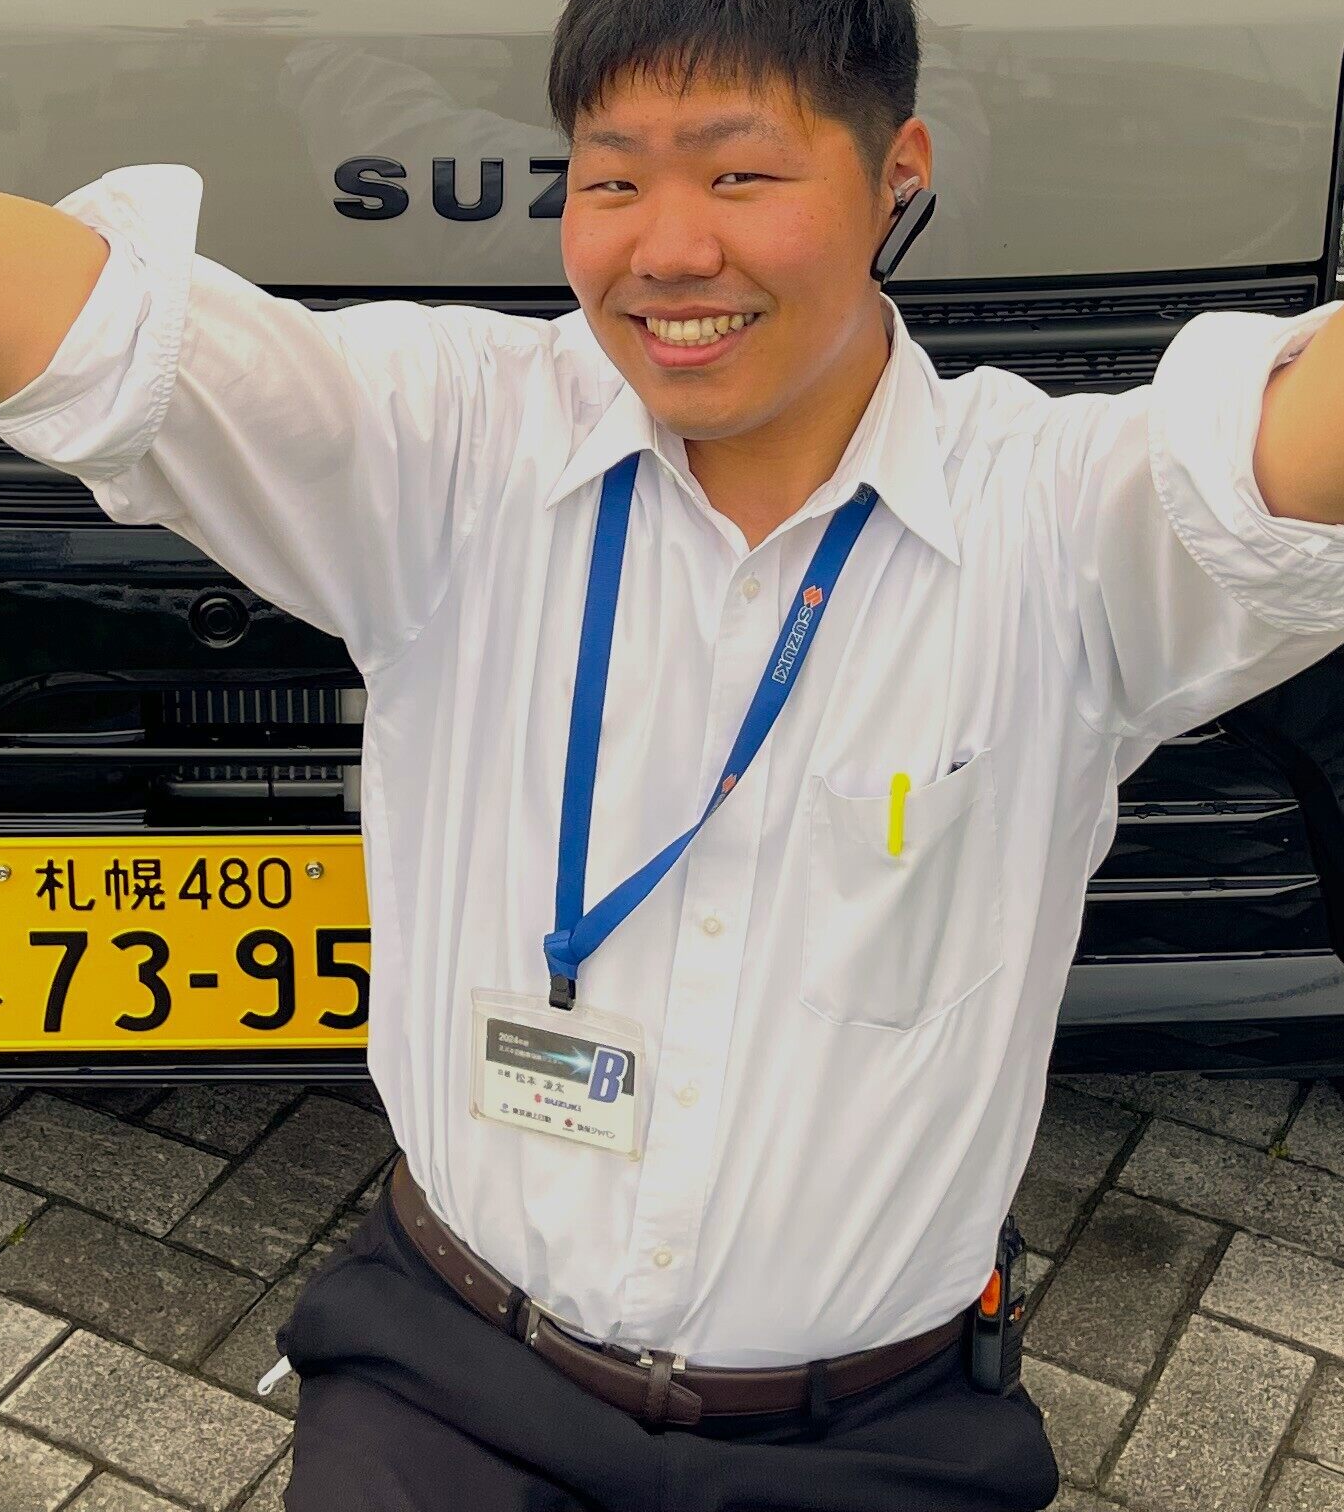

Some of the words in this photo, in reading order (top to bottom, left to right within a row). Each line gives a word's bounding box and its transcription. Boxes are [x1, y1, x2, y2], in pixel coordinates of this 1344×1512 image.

[772, 606, 814, 685] SUZUKI
[35, 857, 166, 912] 札幌
[178, 856, 293, 910] 480
[29, 927, 372, 1033] 73-95
[588, 1047, 629, 1104] B
